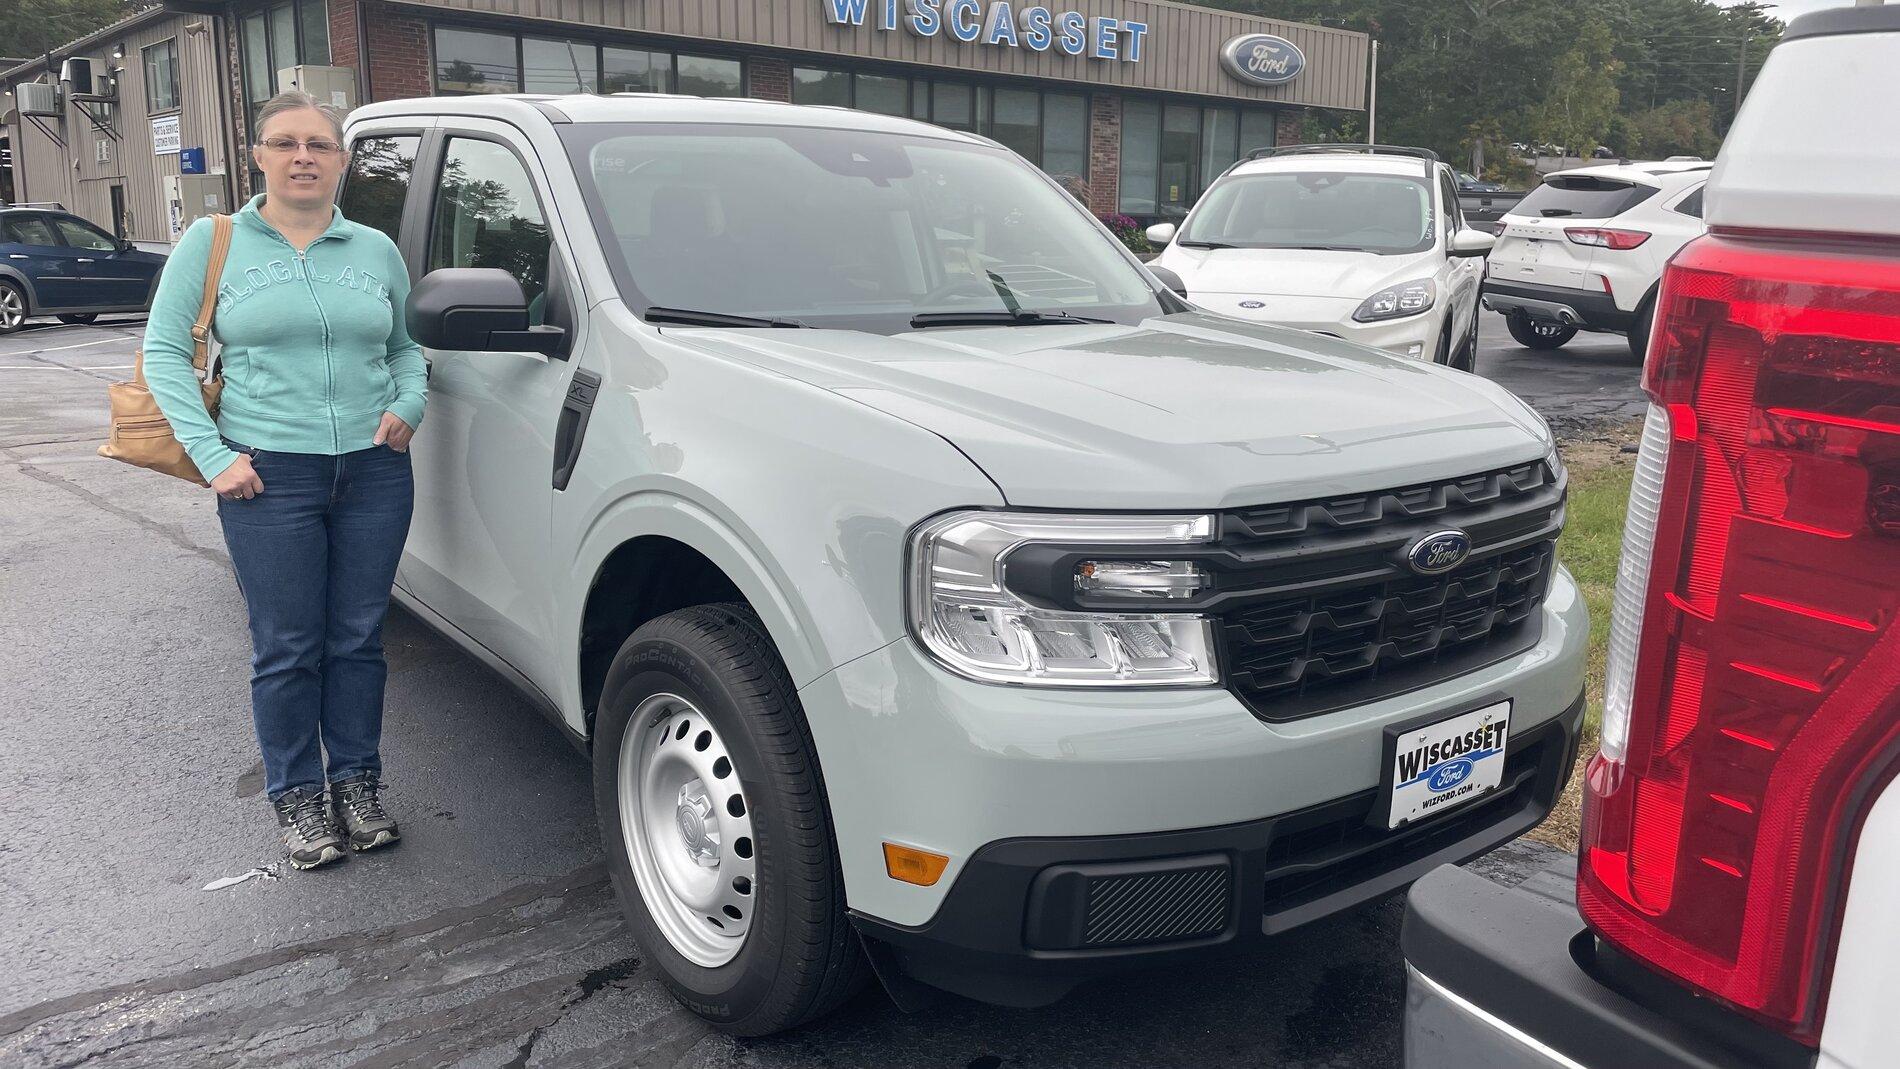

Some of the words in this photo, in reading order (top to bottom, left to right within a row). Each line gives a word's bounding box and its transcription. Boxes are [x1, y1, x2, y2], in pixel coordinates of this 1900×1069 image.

[826, 0, 1148, 62] WISCASSET
[1248, 44, 1290, 75] Ford
[571, 384, 588, 399] XL
[1427, 540, 1461, 566] Ford
[1398, 719, 1507, 783] WISCASSET
[1437, 763, 1466, 787] Ford
[1422, 783, 1474, 810] WIZFORD.COM
